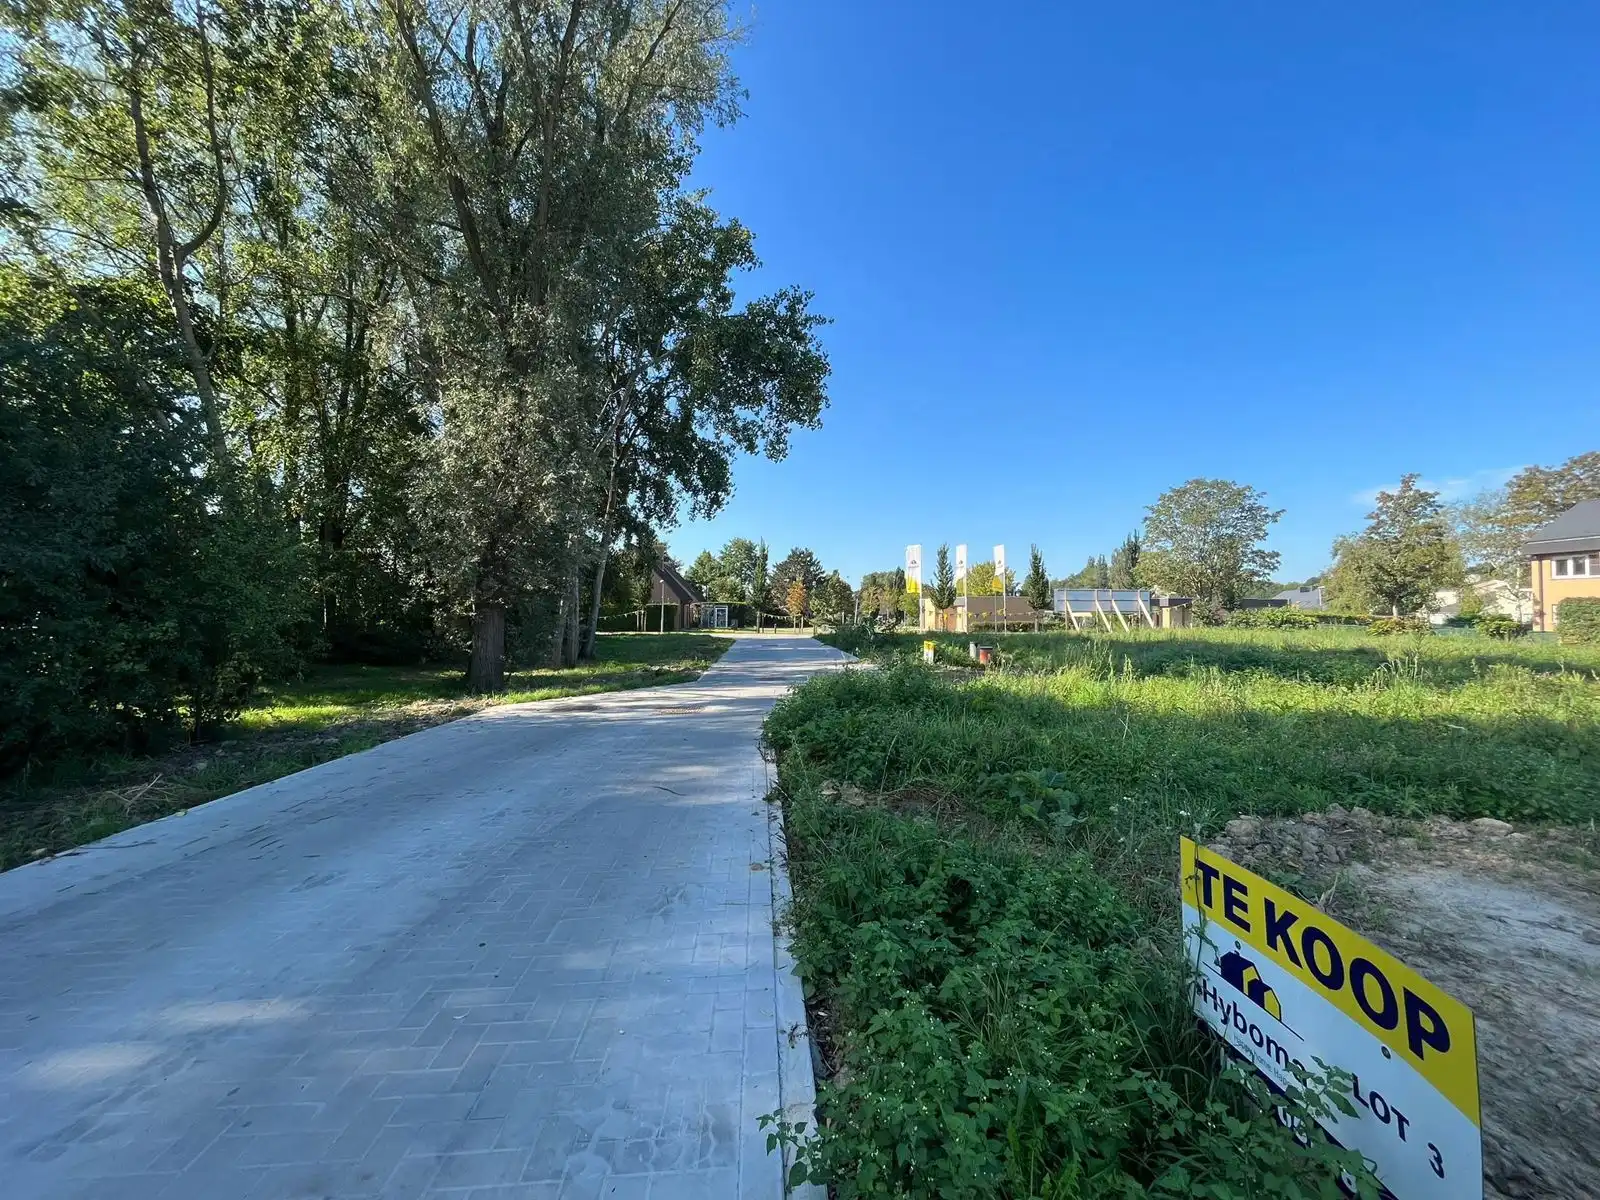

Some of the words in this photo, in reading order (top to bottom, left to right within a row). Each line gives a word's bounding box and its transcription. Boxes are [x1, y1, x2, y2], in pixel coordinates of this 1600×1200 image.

[1196, 860, 1250, 933] TE
[1264, 897, 1451, 1061] KOOP
[1352, 1073, 1410, 1142] LOT
[1427, 1142, 1445, 1179] 3
